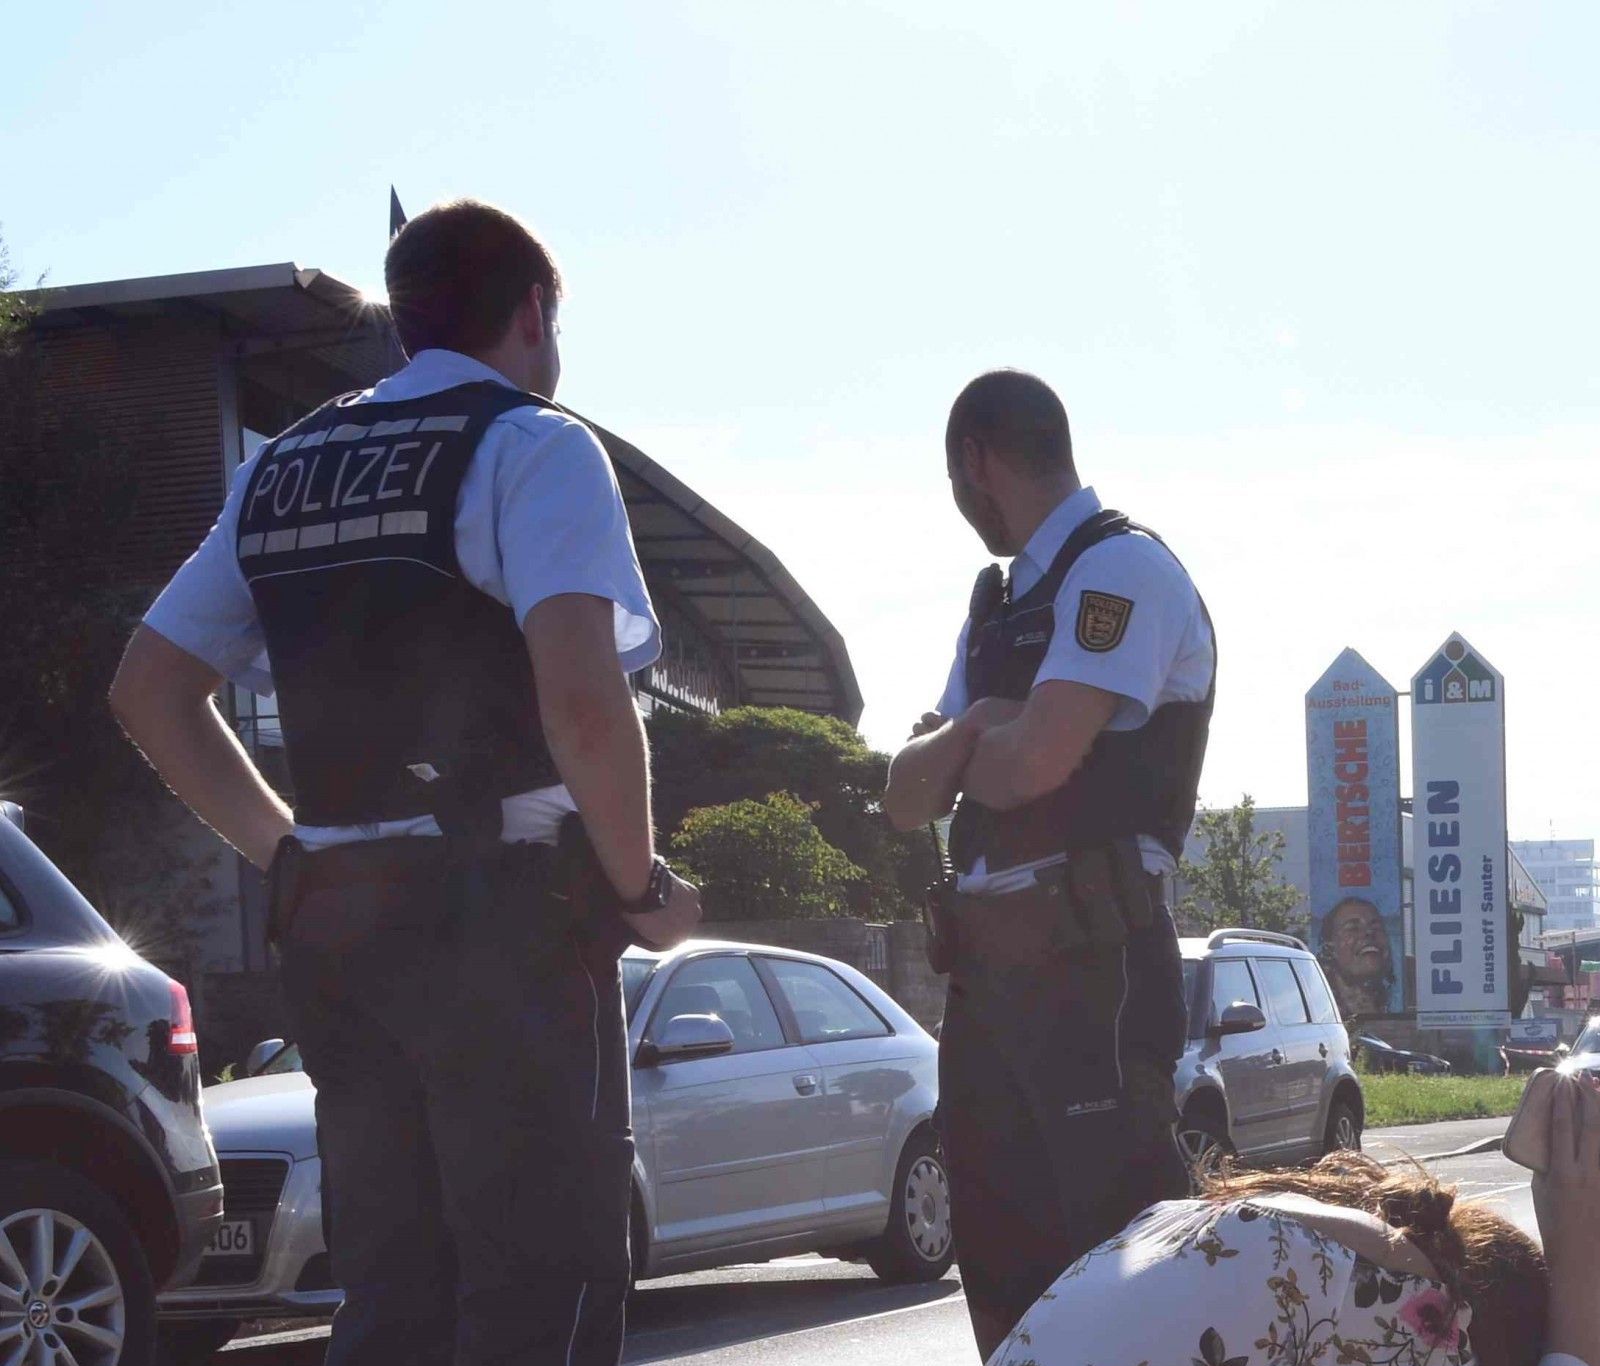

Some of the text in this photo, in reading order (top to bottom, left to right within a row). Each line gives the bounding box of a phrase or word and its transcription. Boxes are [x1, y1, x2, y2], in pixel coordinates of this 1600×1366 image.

[247, 441, 443, 521] POLIZEI
[1307, 694, 1391, 710] Ausstellung
[1332, 679, 1365, 692] Bad-
[1333, 719, 1372, 888] BERTSCHE
[1426, 780, 1464, 995] FLIESEN
[1480, 854, 1496, 995] Baustoff Sauter
[208, 1223, 248, 1251] 06
